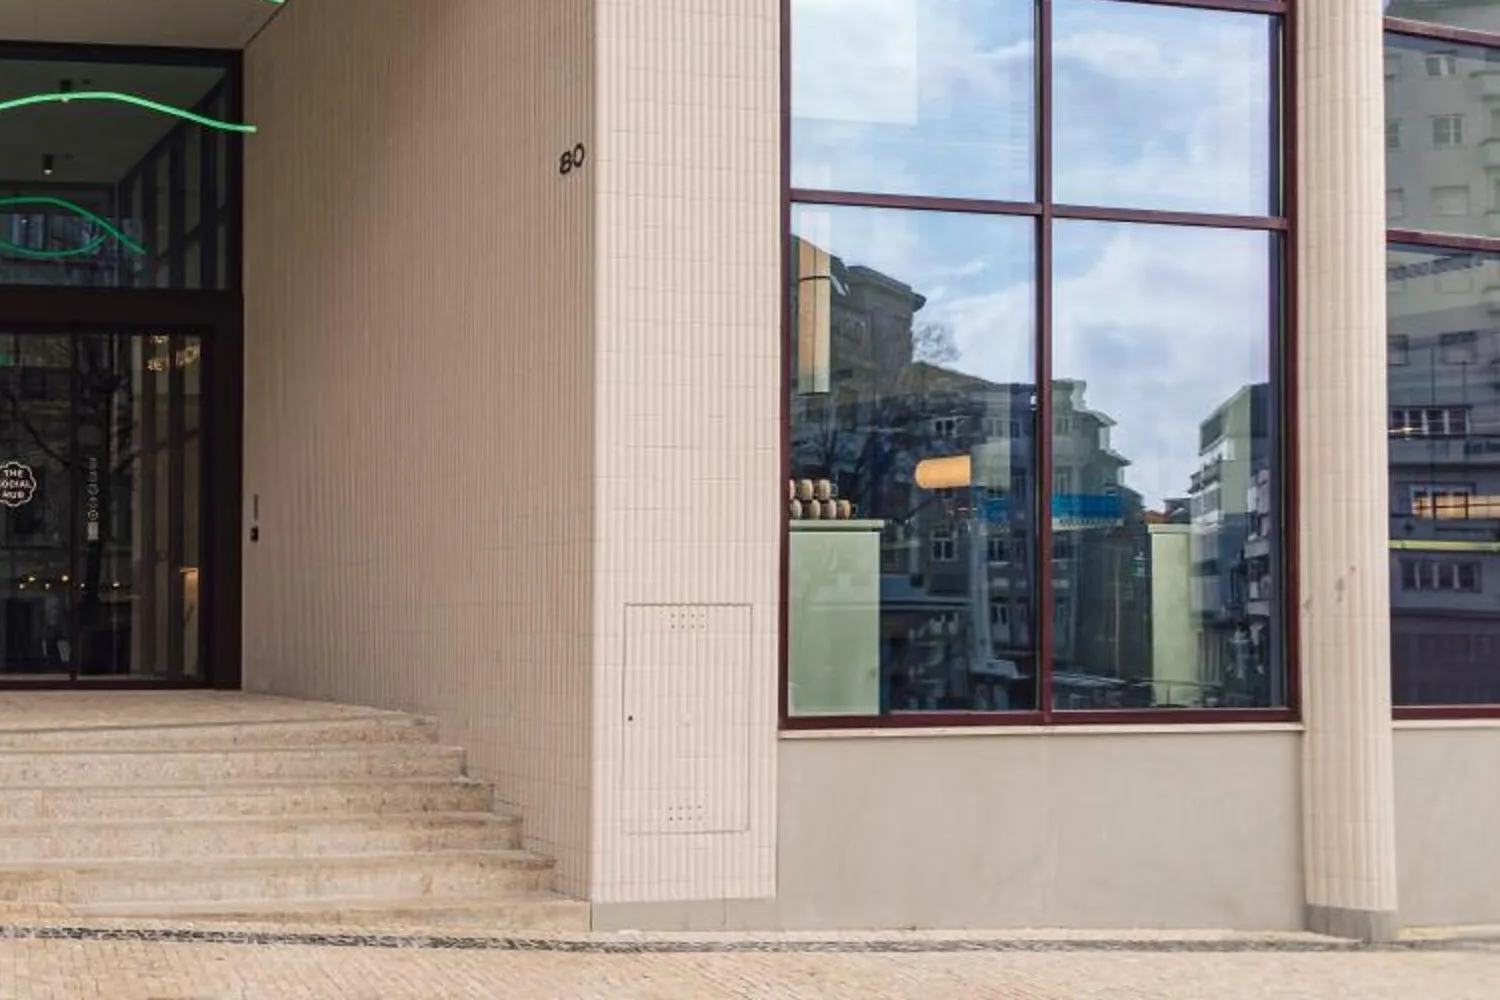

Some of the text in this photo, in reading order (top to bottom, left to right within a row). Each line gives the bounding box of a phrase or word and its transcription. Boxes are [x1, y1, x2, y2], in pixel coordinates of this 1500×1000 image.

[559, 141, 585, 175] 80
[3, 469, 24, 478] THE
[2, 491, 26, 500] HUB
